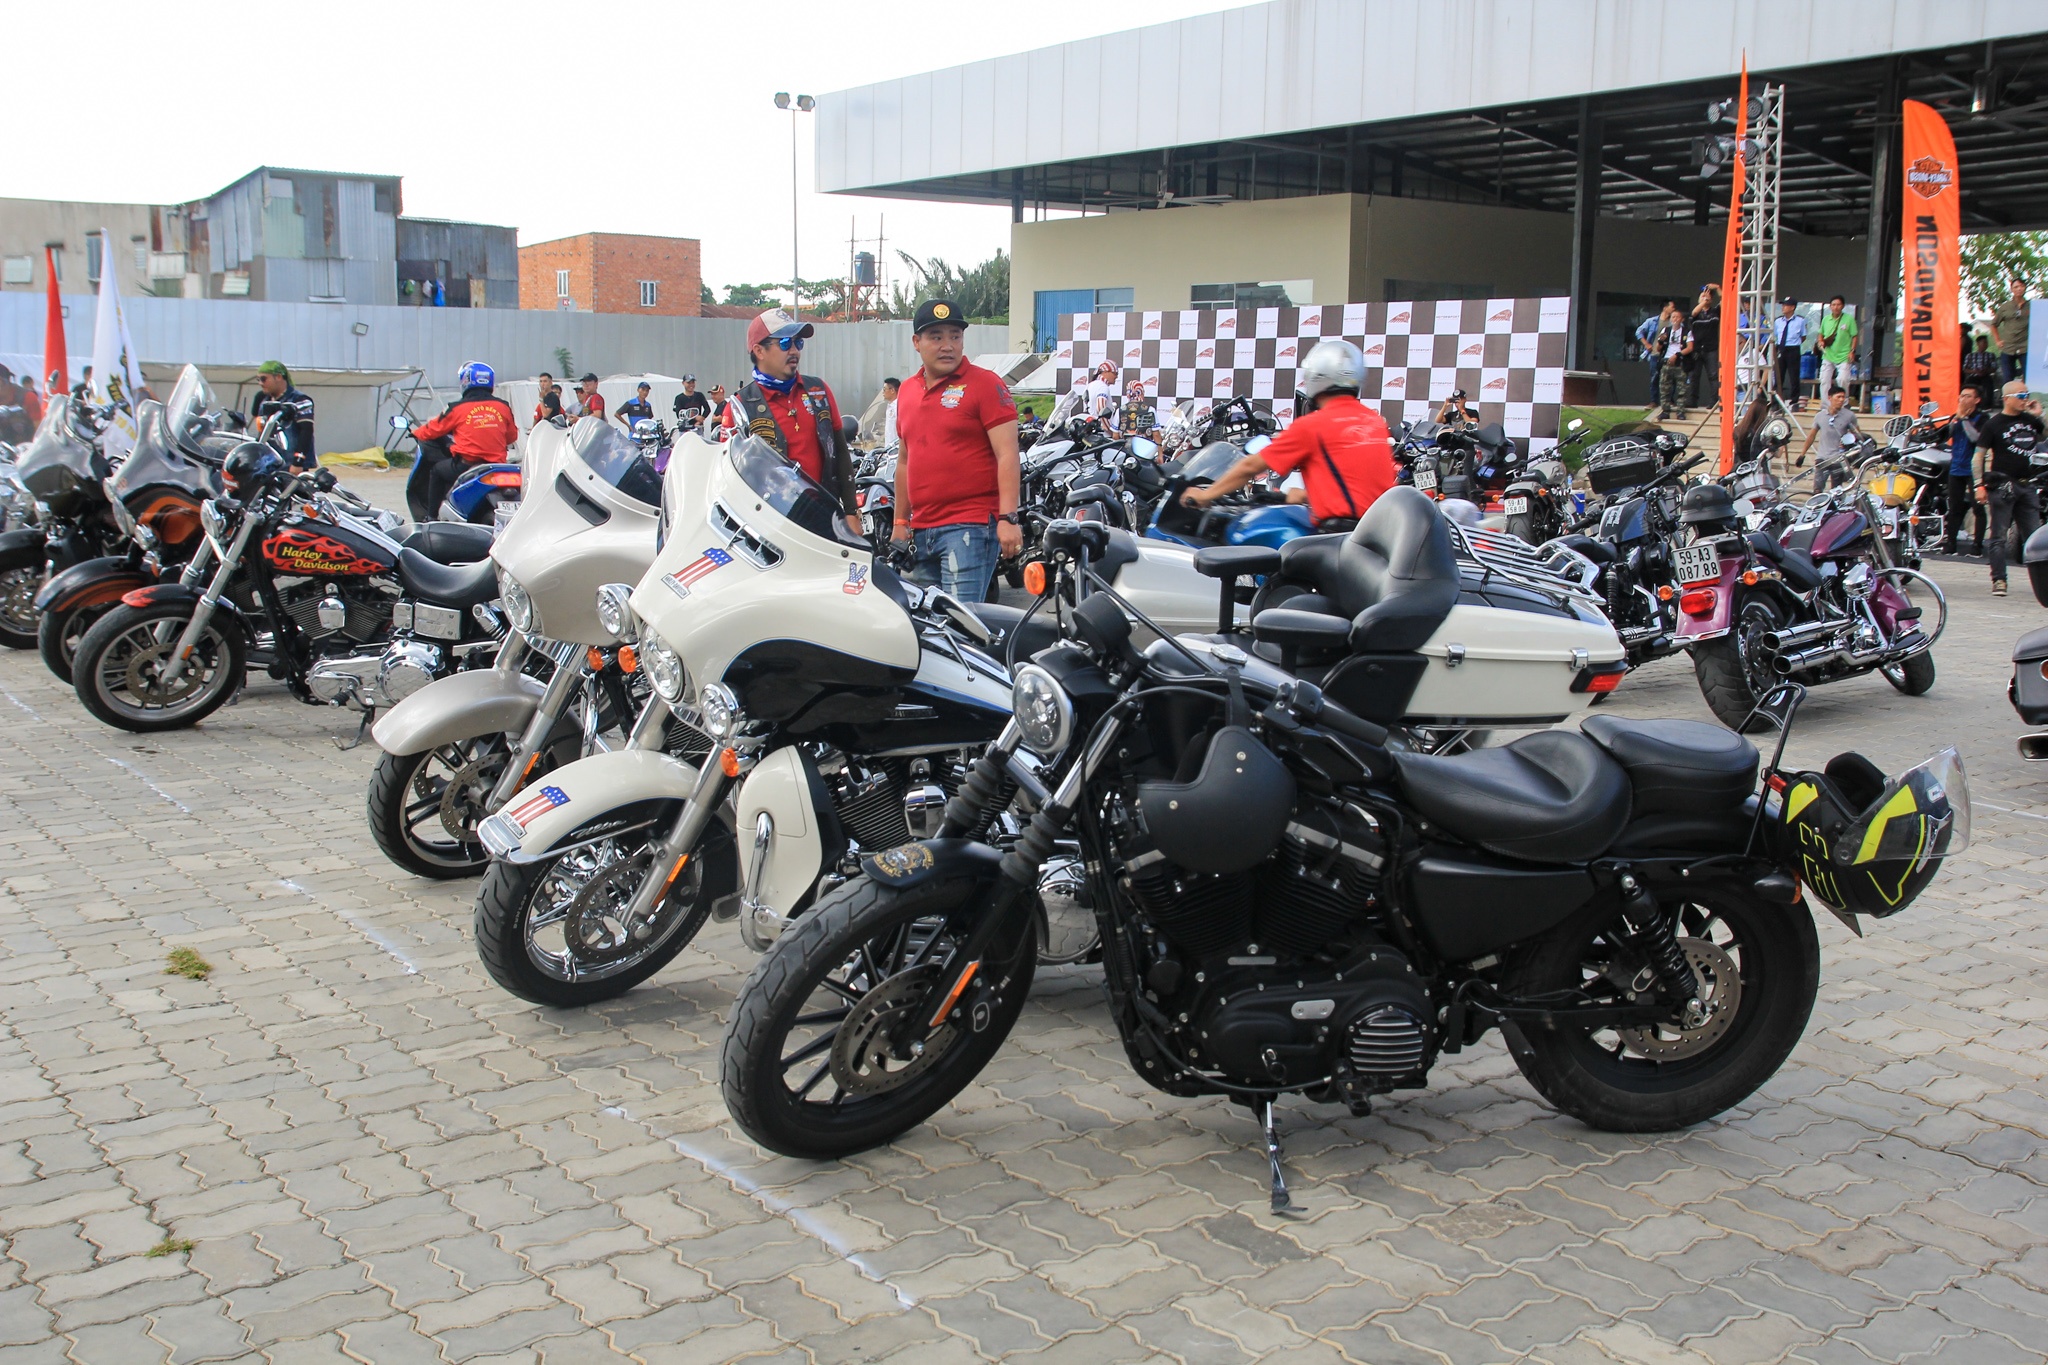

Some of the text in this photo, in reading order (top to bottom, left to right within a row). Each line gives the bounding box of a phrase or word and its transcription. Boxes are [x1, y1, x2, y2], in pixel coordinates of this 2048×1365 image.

[282, 546, 322, 561] Harley
[1679, 548, 1711, 565] 59-A3
[294, 559, 349, 571] Davidson
[1679, 562, 1718, 580] 087.88
[513, 894, 527, 929] DUNLOP
